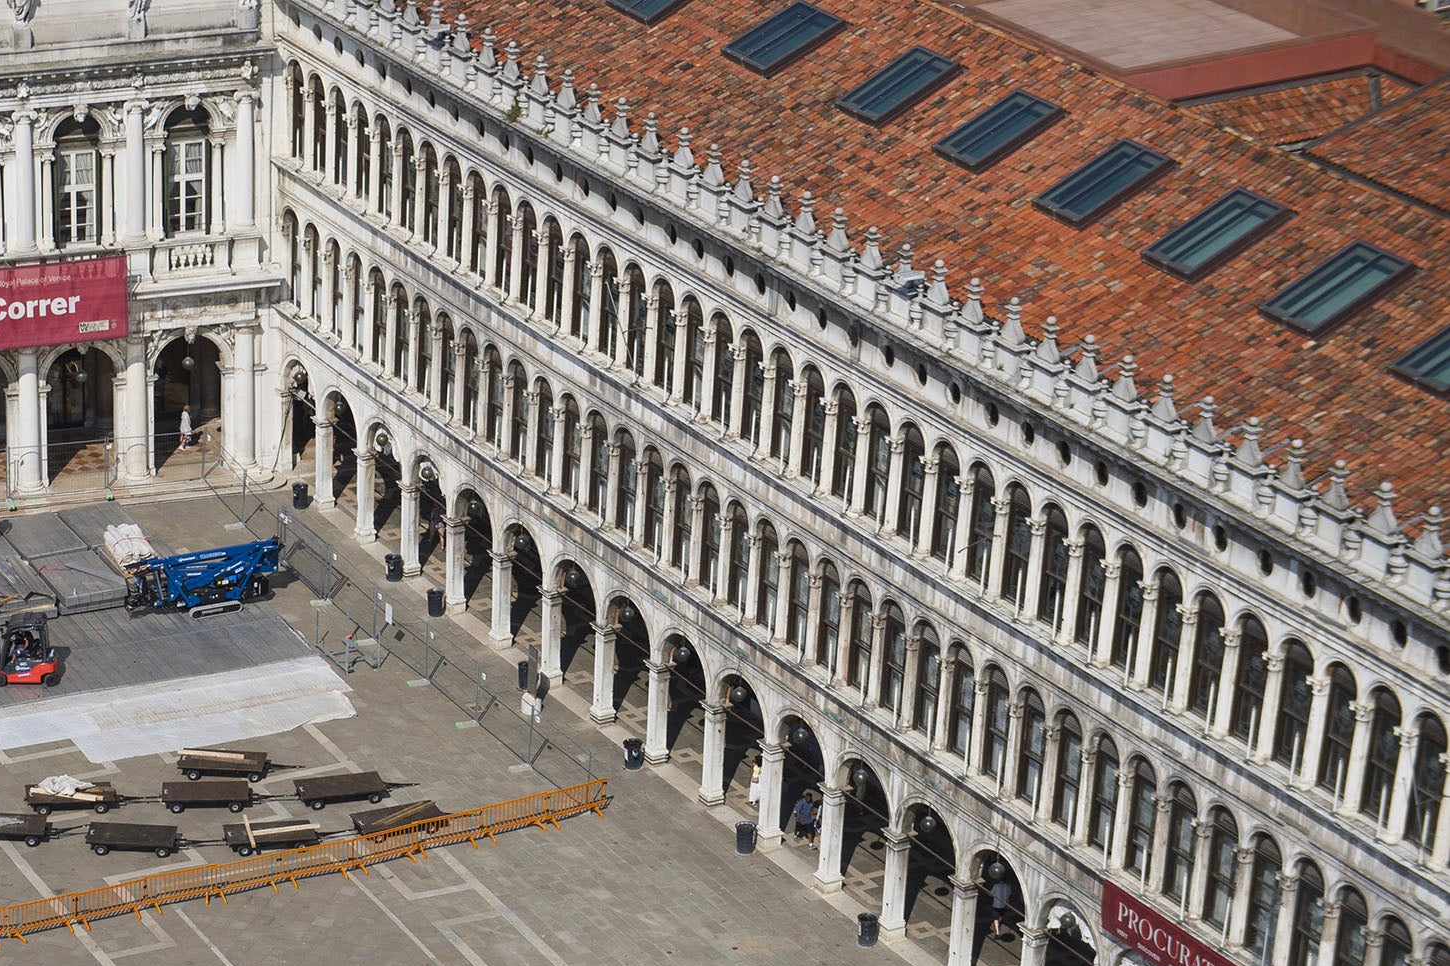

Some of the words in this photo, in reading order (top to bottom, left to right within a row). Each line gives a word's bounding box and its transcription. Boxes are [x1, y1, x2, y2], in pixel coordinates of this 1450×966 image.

[16, 277, 40, 286] Palace
[48, 274, 72, 283] Venice
[1136, 942, 1162, 962] DISCOVER
